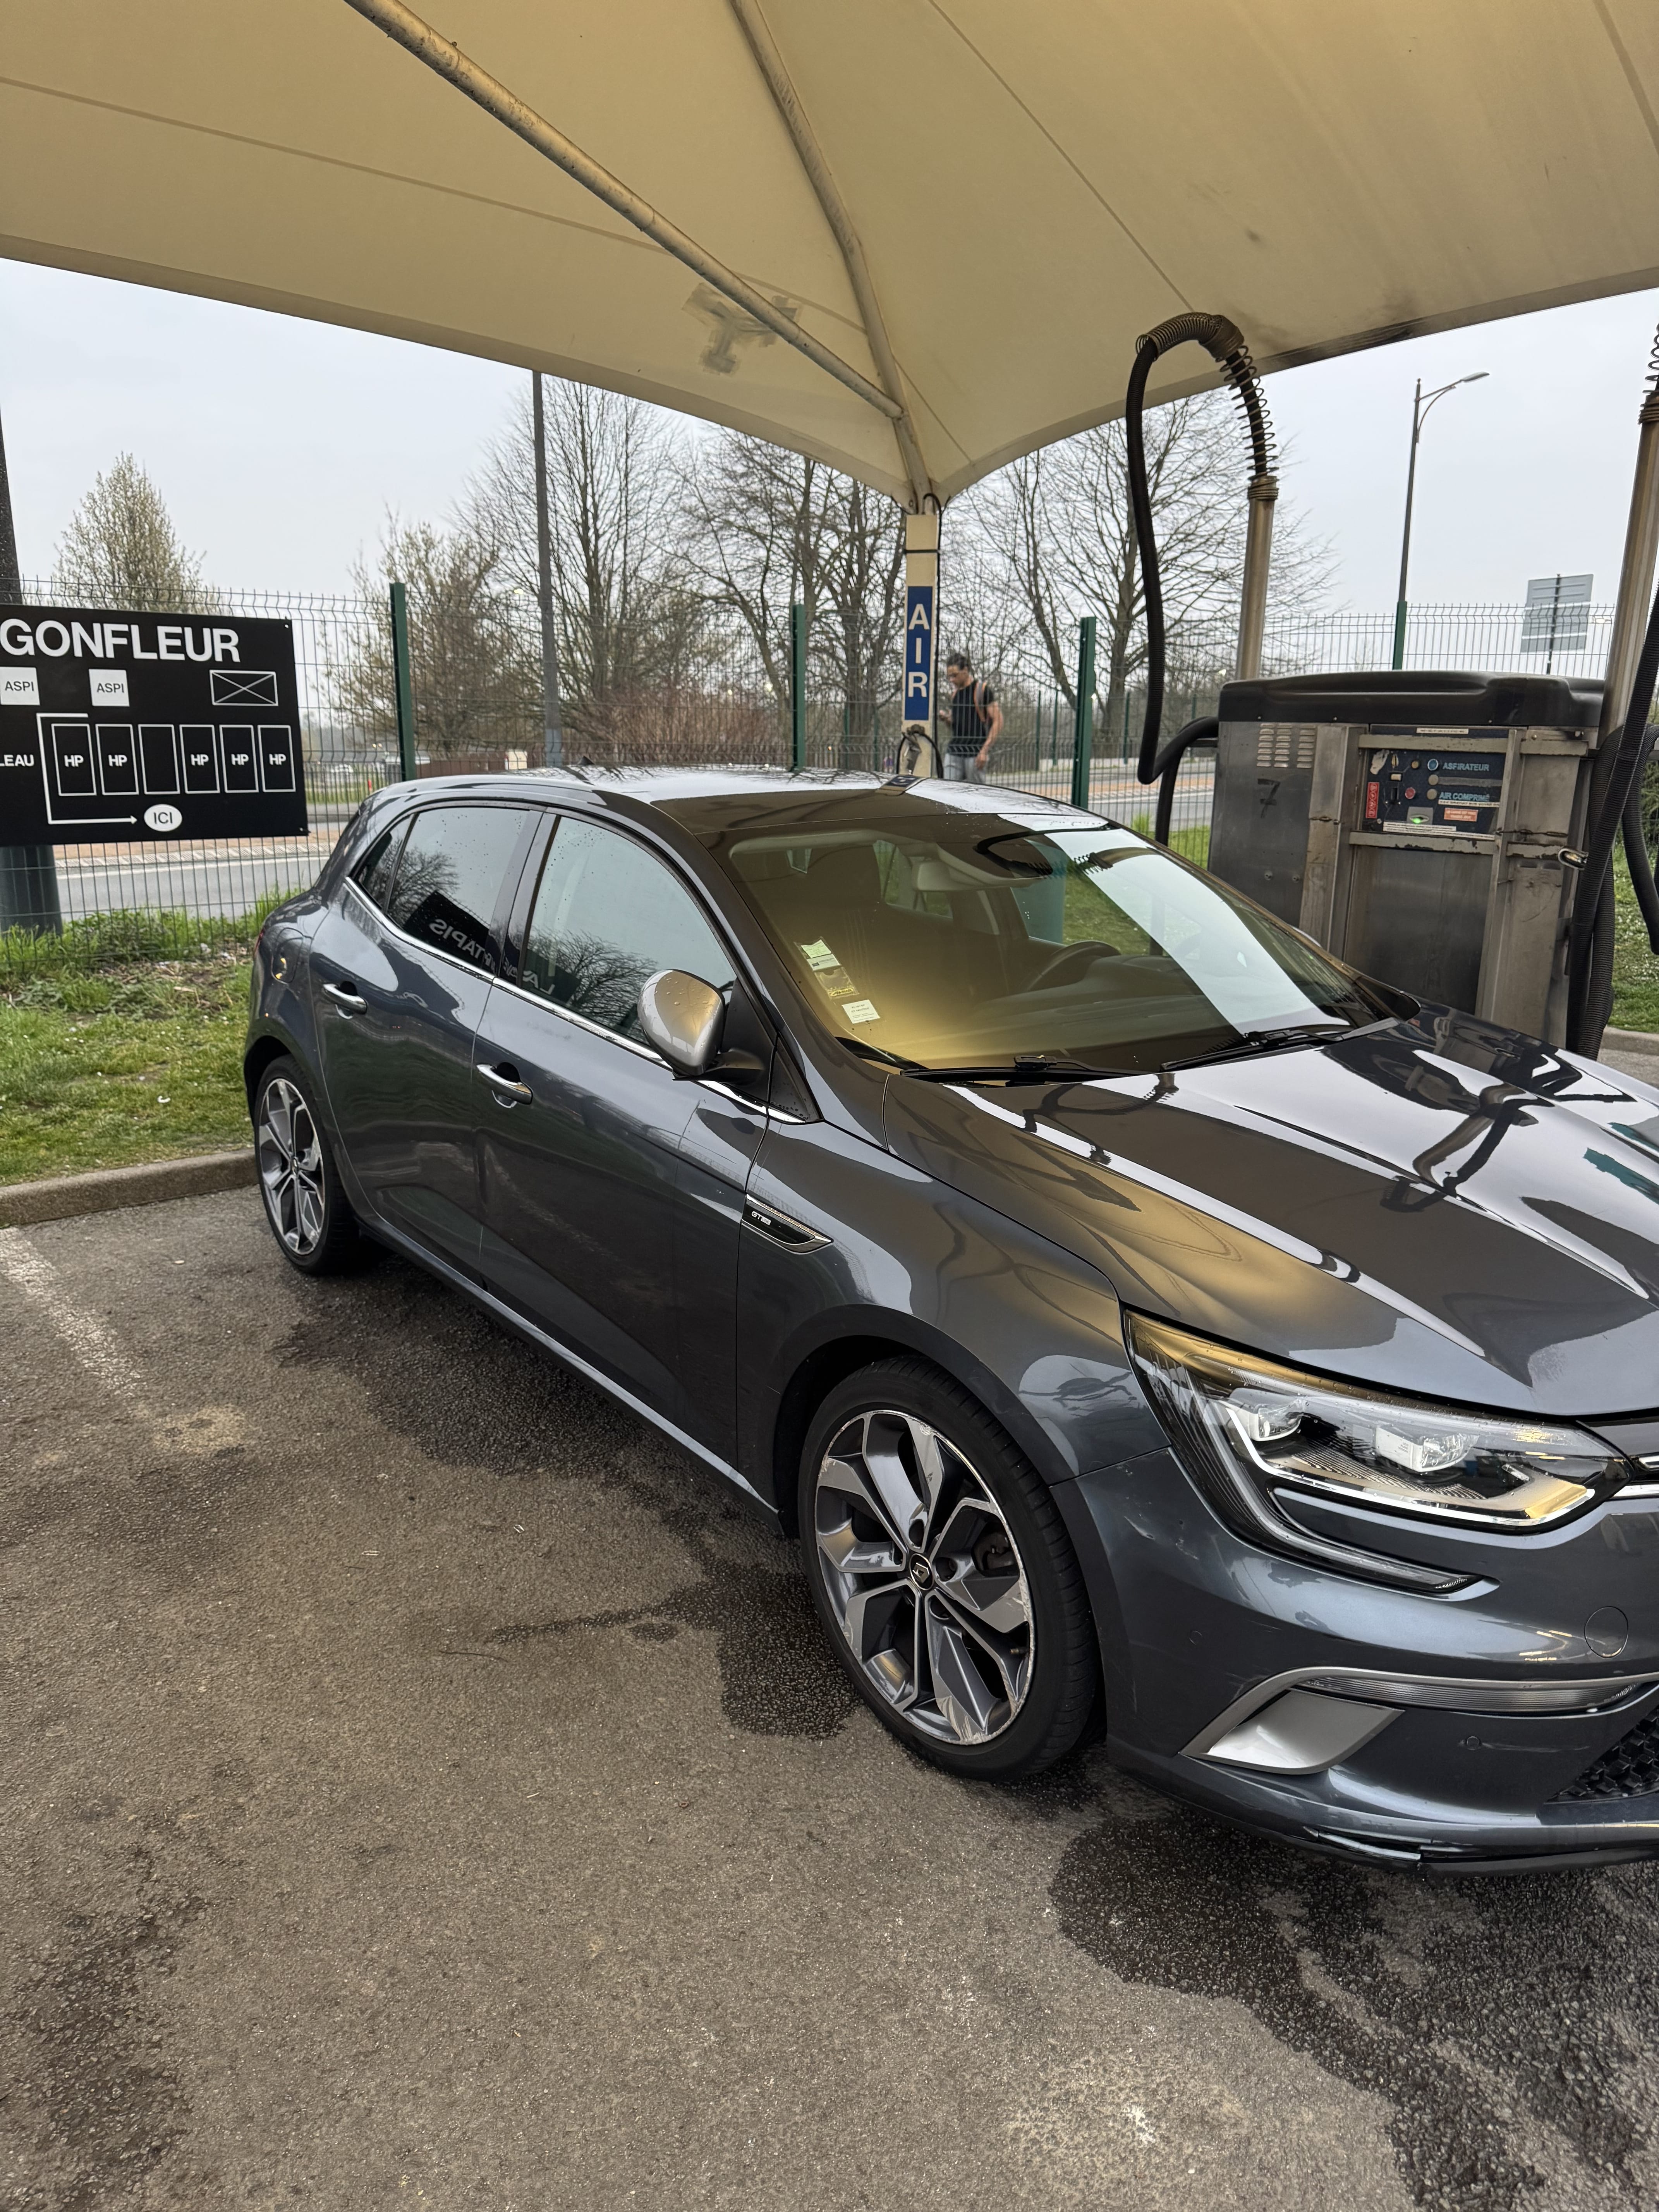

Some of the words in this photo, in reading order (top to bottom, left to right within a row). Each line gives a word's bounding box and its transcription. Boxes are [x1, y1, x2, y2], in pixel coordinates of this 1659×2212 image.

[0, 619, 240, 662] GONFLEUR
[908, 603, 930, 698] AIR
[5, 681, 34, 691] ASPI
[97, 683, 124, 693] ASPI
[64, 755, 84, 767] HP
[108, 755, 127, 766] HP
[191, 754, 209, 766] HP
[231, 754, 249, 765] HP
[269, 754, 287, 765] HP
[154, 812, 173, 824] ICI
